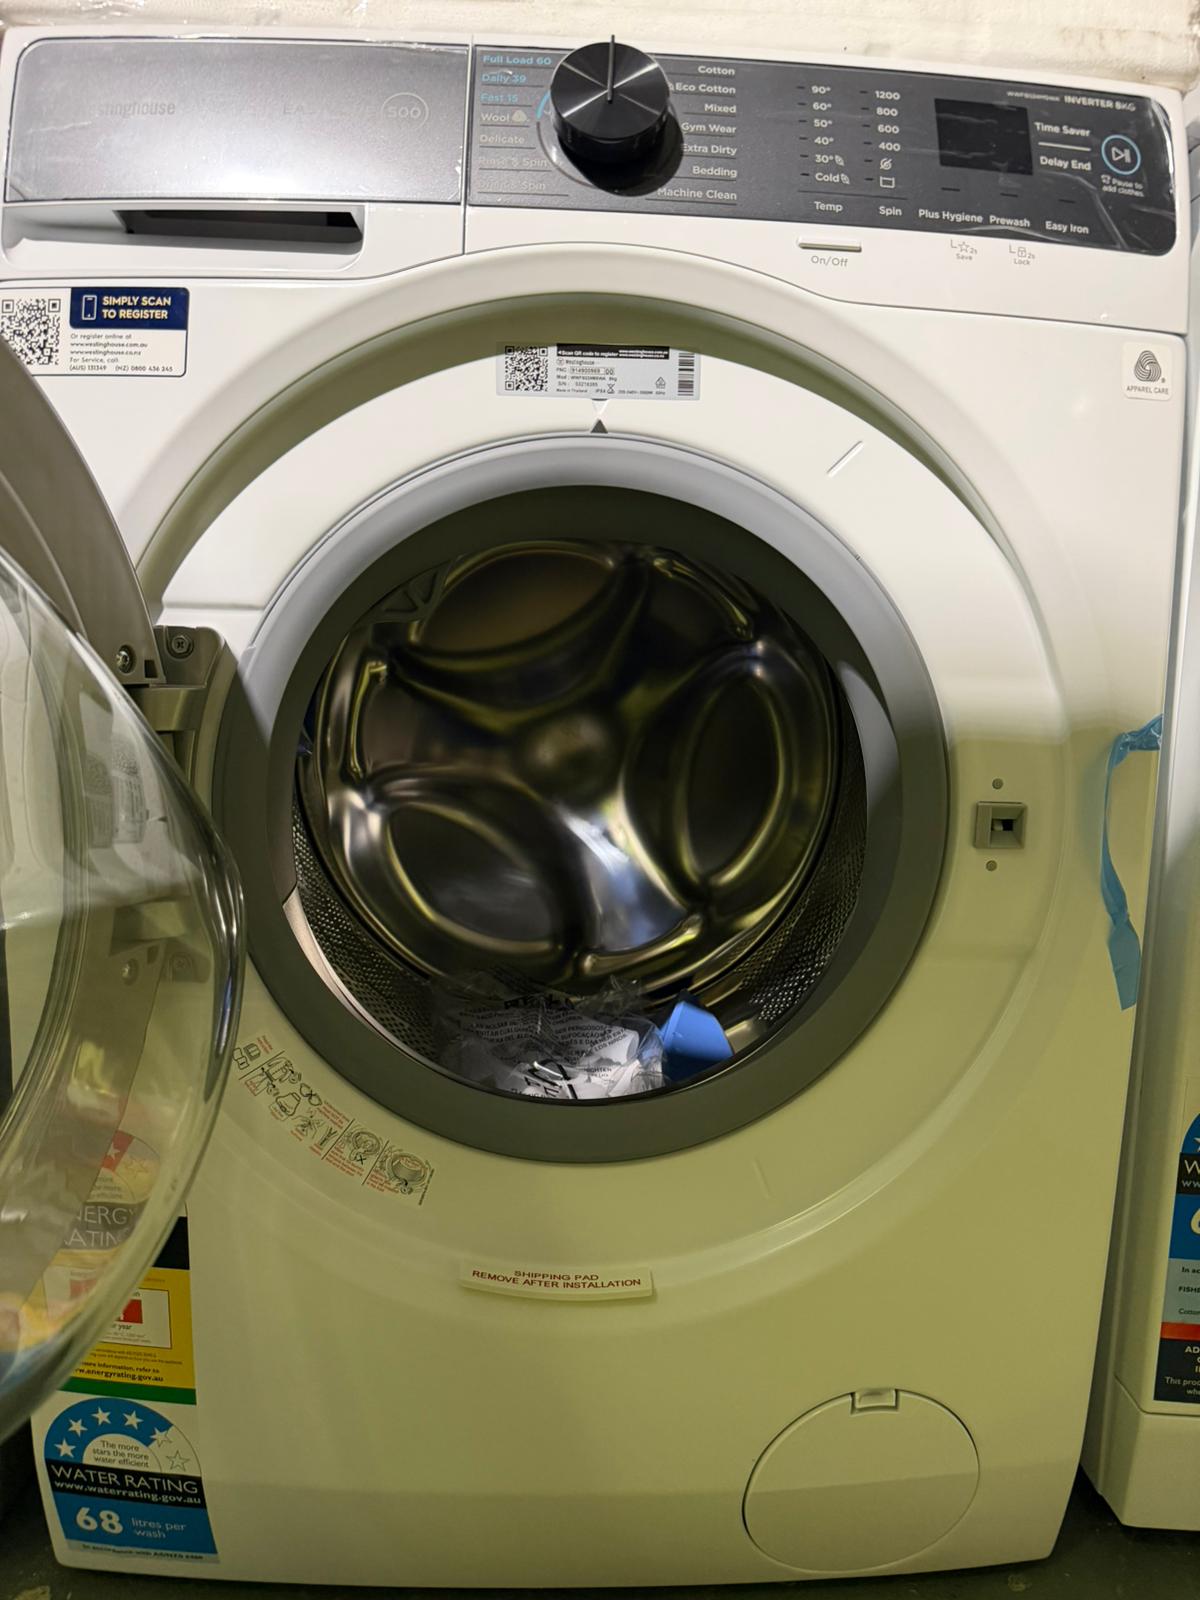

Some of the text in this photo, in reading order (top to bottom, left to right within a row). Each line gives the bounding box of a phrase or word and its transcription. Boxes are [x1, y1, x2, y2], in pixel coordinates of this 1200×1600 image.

[482, 55, 552, 66] Full Load 60
[697, 65, 736, 76] Cotton
[481, 73, 527, 85] Daily 39
[675, 82, 737, 94] Eco Cotton
[480, 92, 519, 103] Fast 15
[874, 90, 901, 101] 1200
[704, 103, 737, 114] Mixed
[1064, 95, 1114, 109] INVERTER
[1115, 100, 1137, 112] 8KG
[387, 106, 421, 123] 500
[480, 112, 510, 122] Wool
[876, 106, 899, 117] 800
[681, 122, 737, 134] Gym Wear
[877, 124, 900, 135] 600
[1034, 121, 1092, 137] Time Saver
[479, 134, 525, 145] Delicate
[682, 142, 737, 155] Extra Dirty
[878, 142, 902, 152] 400
[522, 158, 548, 168] Spin
[1039, 155, 1092, 171] Delay End
[692, 165, 738, 177] Bedding
[815, 172, 840, 183] Cold
[1111, 178, 1134, 188] Pause
[657, 187, 738, 201] Machine Clean
[1101, 185, 1117, 193] add
[813, 200, 844, 213] Temp
[878, 205, 903, 217] Spin
[918, 208, 984, 224] Plus Hygiene
[989, 214, 1031, 228] Prewash
[1045, 220, 1089, 234] Easy Iron
[810, 255, 849, 267] On/Off
[955, 253, 973, 261] Save
[1013, 257, 1031, 266] Lock
[102, 295, 172, 307] SIMPLY SCAN
[102, 309, 169, 320] TO REGISTER
[80, 333, 103, 342] register
[69, 364, 86, 372] (AUS)
[1126, 384, 1169, 395] APPAREL CARE
[471, 1269, 642, 1290] REMOVE AFTER INSTALLATION
[513, 1269, 600, 1282] SHIPPING PAD
[1164, 1376, 1181, 1386] This
[100, 1439, 140, 1452] The more
[92, 1448, 149, 1461] stars the more
[94, 1455, 149, 1469] water efficient
[50, 1464, 199, 1495] WATER RATING
[54, 1480, 202, 1505] www.waterrating.gov.au
[75, 1506, 124, 1535] 68
[131, 1516, 187, 1534] litres per
[133, 1528, 166, 1539] wash
